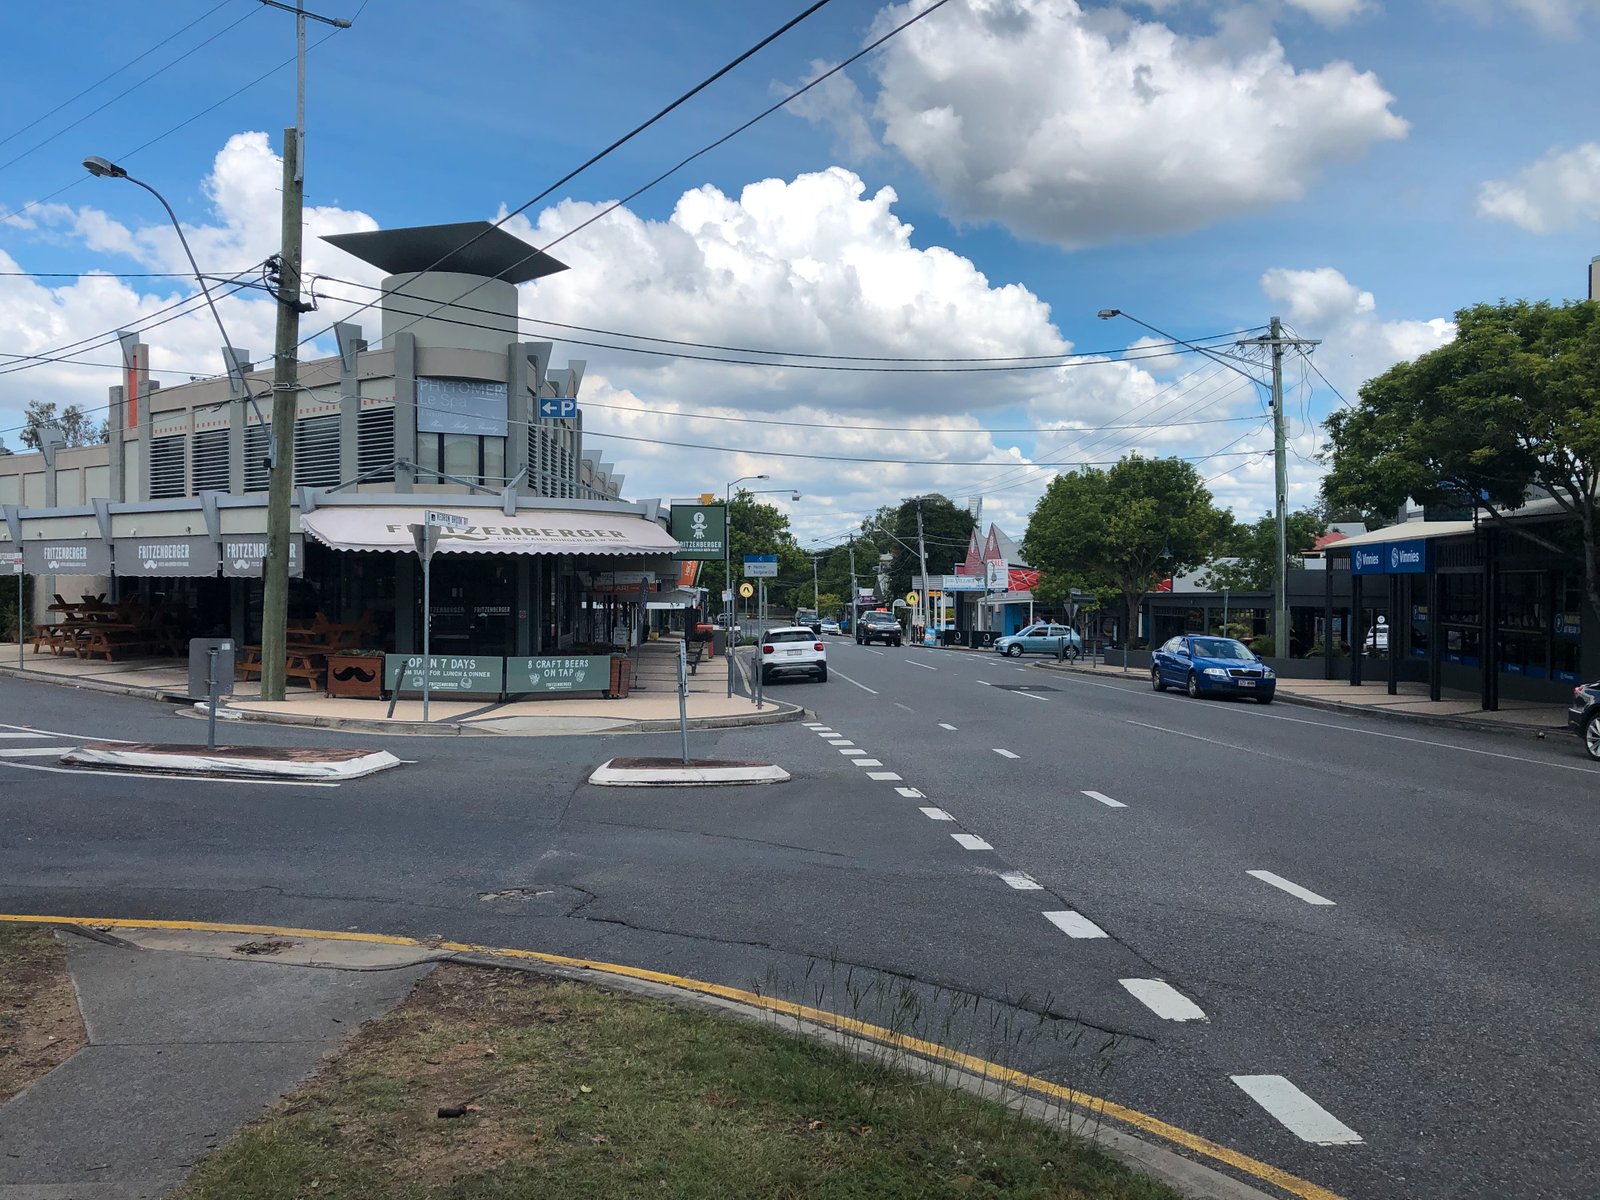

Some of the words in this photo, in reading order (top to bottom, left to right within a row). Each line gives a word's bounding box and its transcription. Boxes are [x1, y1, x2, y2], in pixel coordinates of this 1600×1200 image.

[420, 380, 505, 397] PHYTOMER
[420, 394, 437, 405] Le
[440, 394, 467, 408] Spa
[561, 402, 574, 416] P
[44, 546, 88, 560] FRITZENBERGER
[138, 544, 190, 559] FRITZENBERGER
[1400, 550, 1420, 562] Vinnies
[1362, 553, 1379, 565] Vinnies
[408, 658, 437, 668] OPN
[441, 658, 447, 668] 7
[451, 659, 476, 669] DAYS
[528, 660, 532, 668] 8
[536, 660, 562, 668] CRAFT
[564, 659, 589, 668] BEERS
[558, 668, 574, 676] TAP
